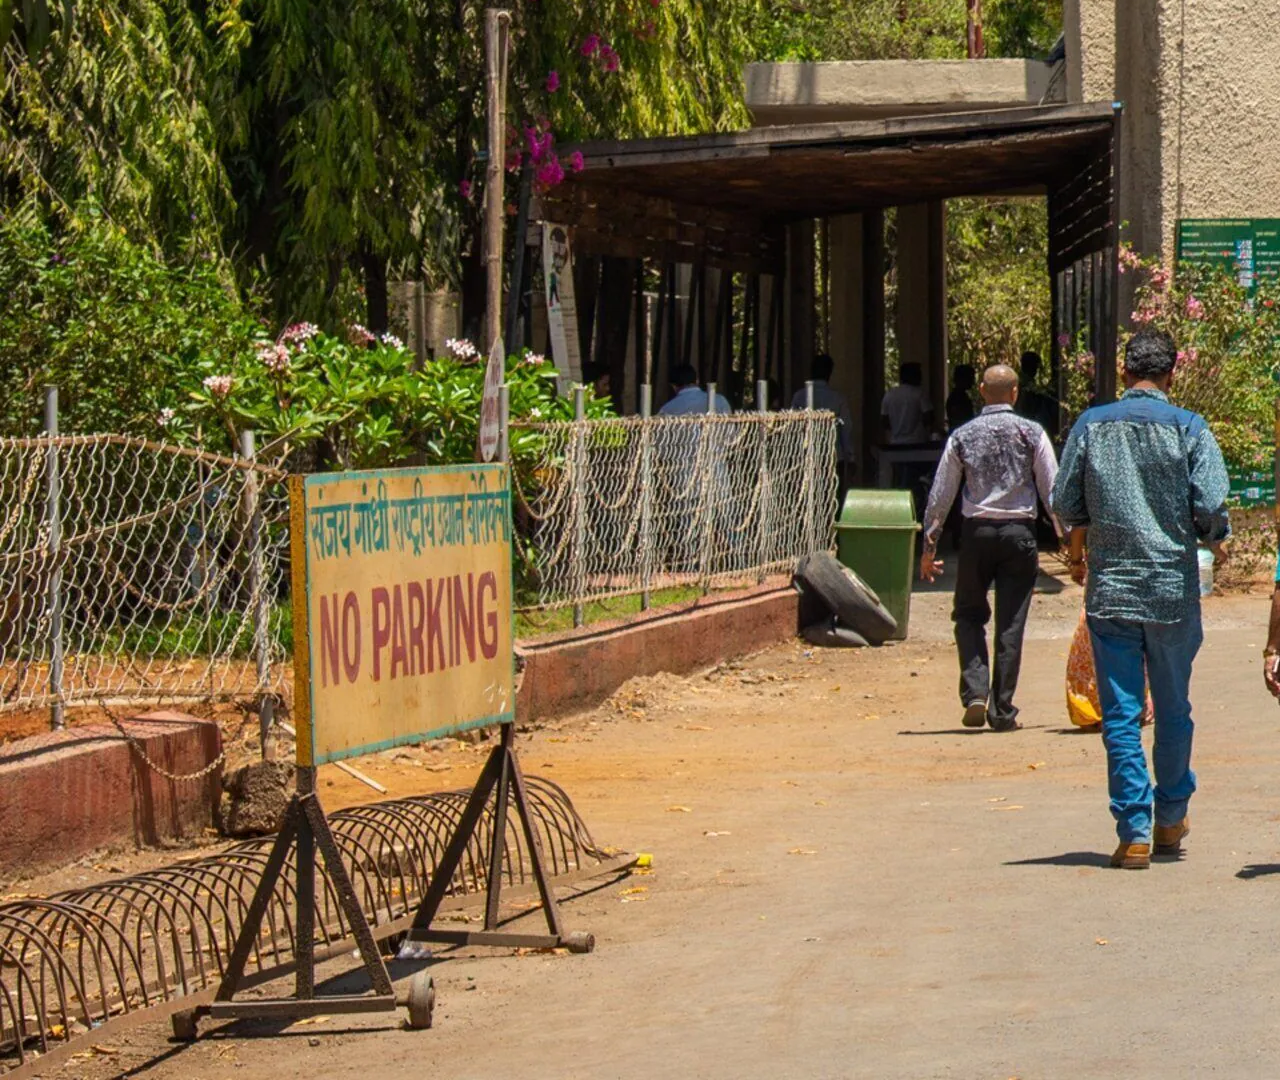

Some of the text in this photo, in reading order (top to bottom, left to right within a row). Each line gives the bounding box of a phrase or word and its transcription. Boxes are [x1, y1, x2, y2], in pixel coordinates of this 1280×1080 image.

[311, 487, 351, 561] संजय
[353, 478, 390, 554] गांधी
[391, 477, 436, 557] राष्ट्रीय
[319, 571, 499, 688] NO PARKING
